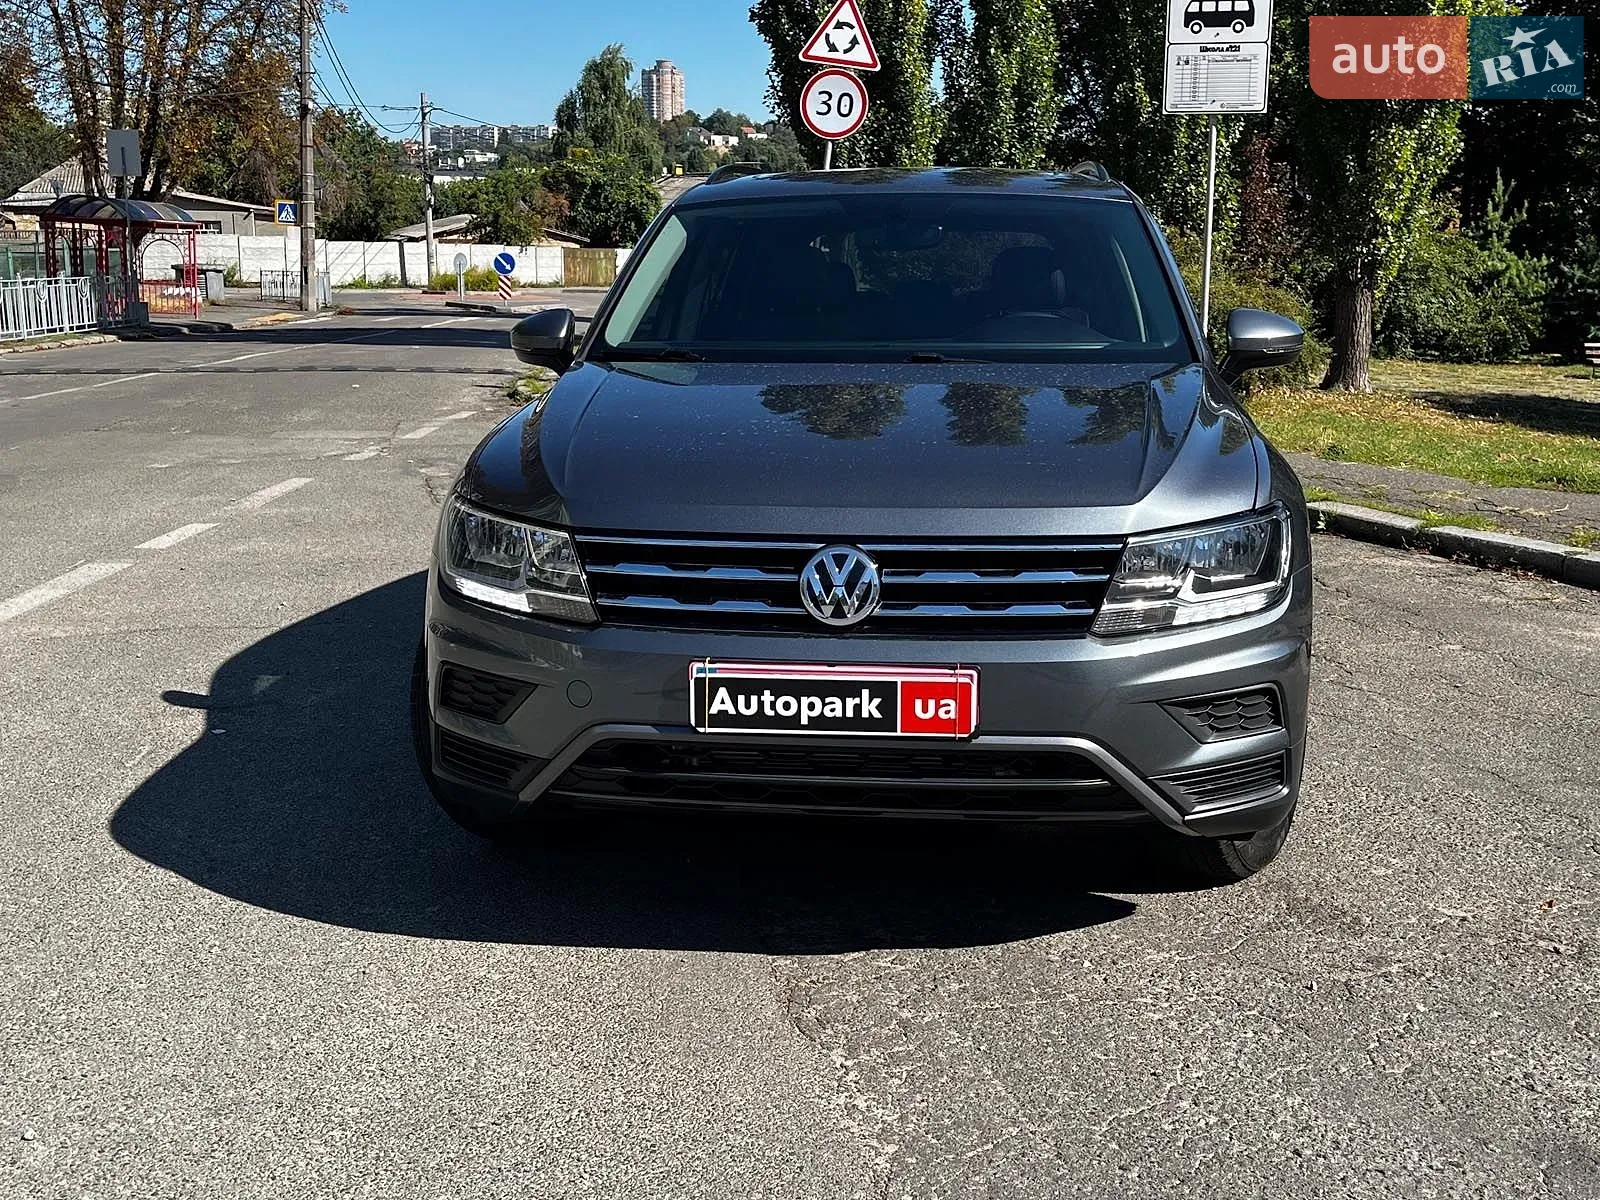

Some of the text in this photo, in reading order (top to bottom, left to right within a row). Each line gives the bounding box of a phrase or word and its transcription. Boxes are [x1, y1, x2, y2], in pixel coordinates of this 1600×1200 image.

[815, 90, 854, 118] 30
[708, 686, 958, 725] Autopark ua
